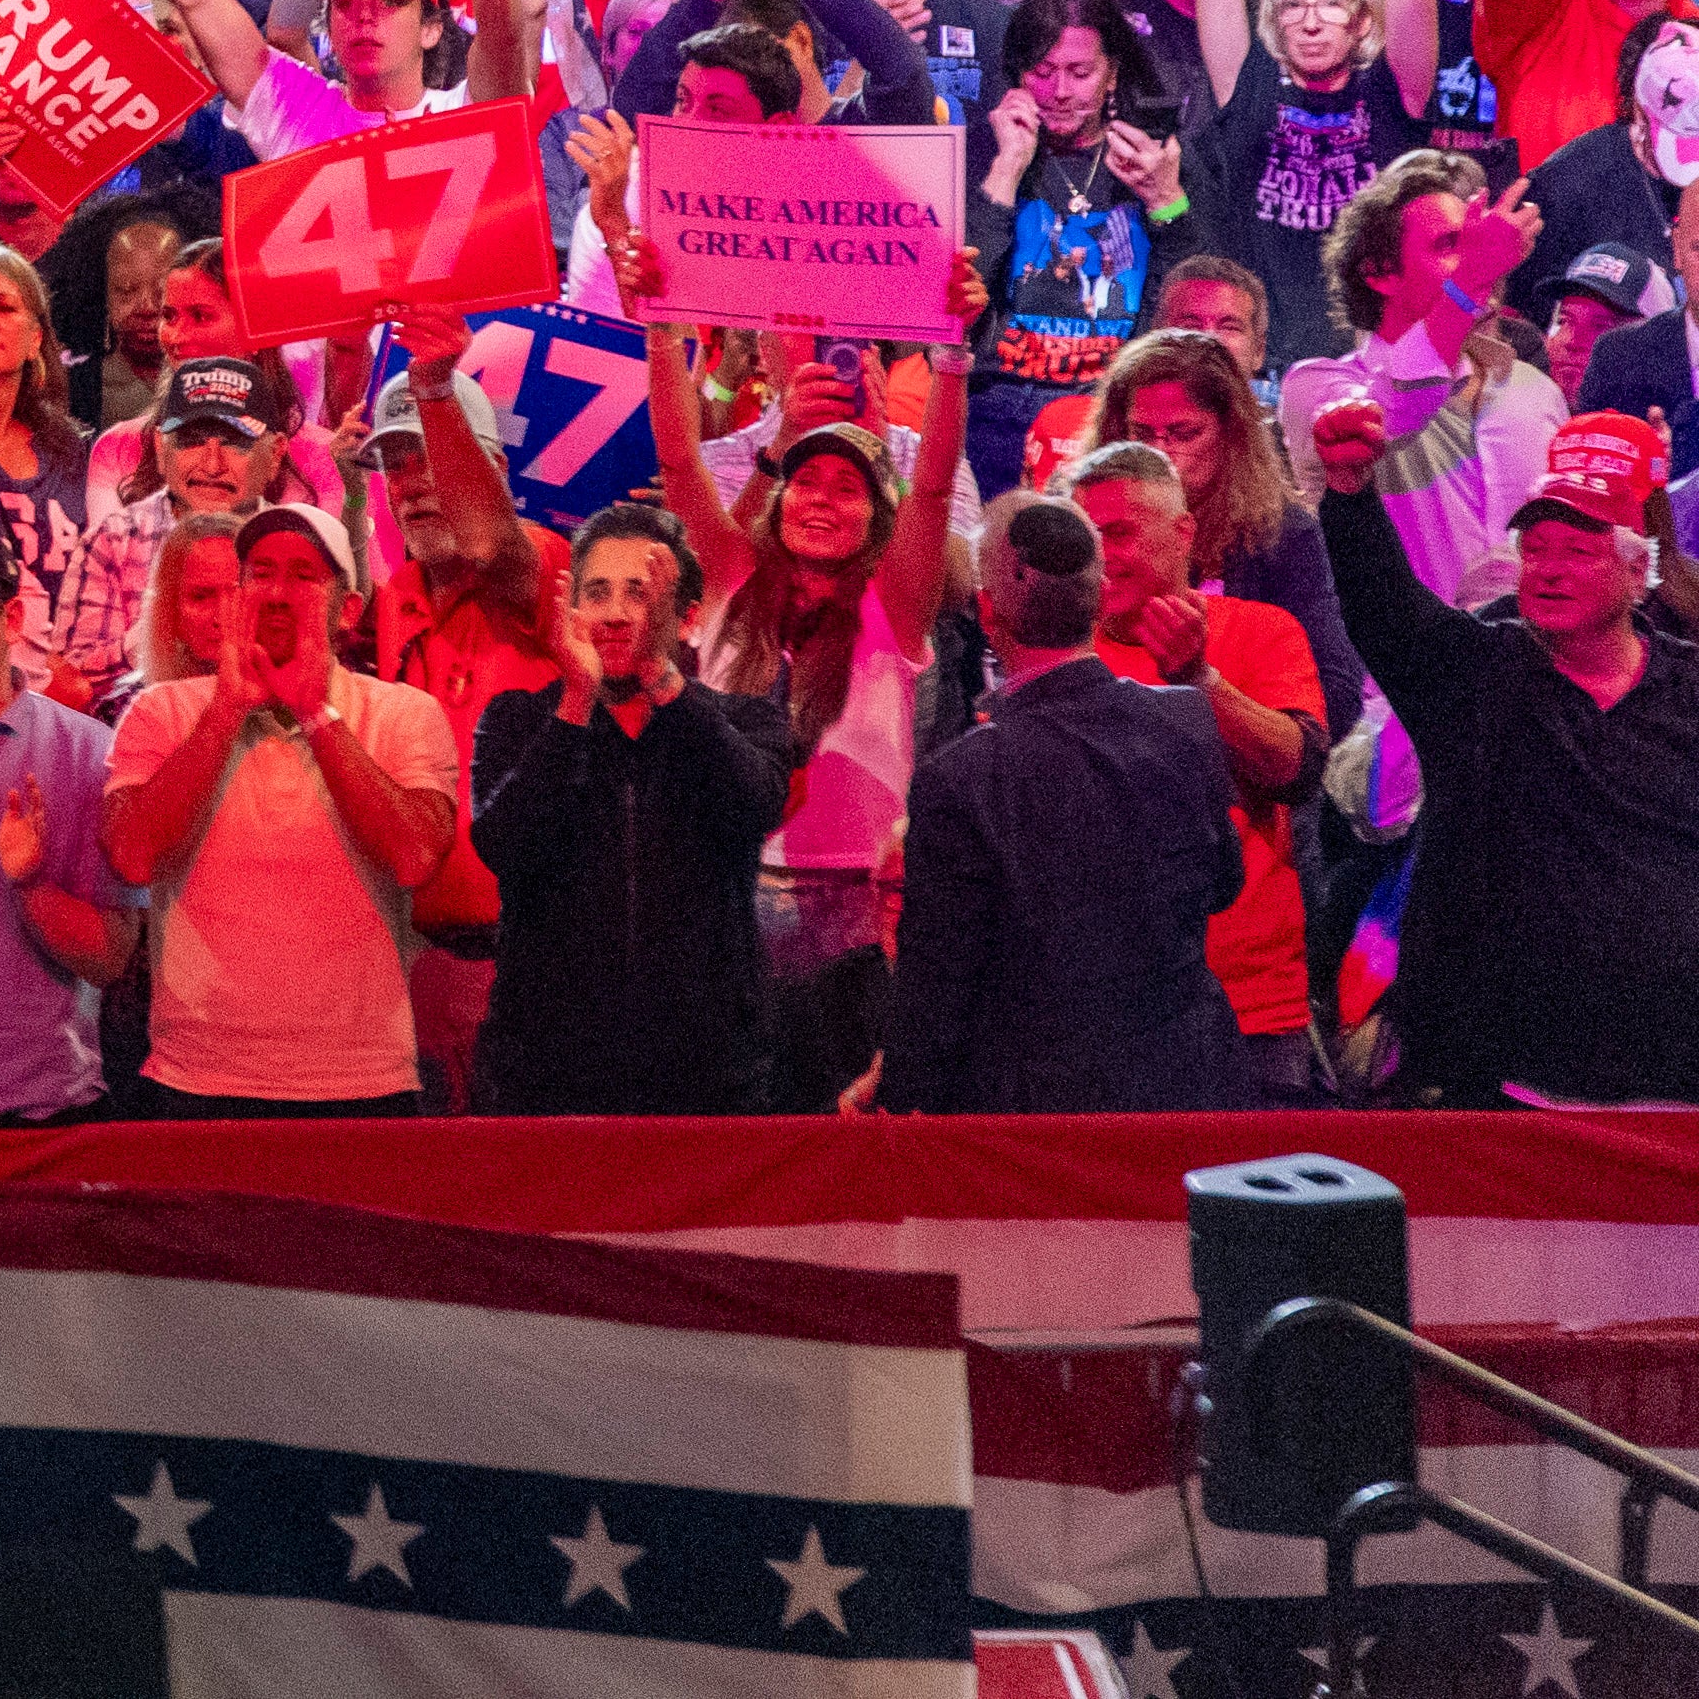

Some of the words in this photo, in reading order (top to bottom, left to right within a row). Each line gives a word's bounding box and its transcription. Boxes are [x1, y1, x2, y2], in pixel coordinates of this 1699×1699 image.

[13, 103, 48, 137] GREAT
[260, 136, 497, 296] 47
[660, 190, 761, 222] MAKE
[769, 198, 943, 229] AMERICA
[1255, 192, 1334, 231] TRU
[677, 229, 798, 260] GREAT
[805, 237, 922, 266] AGAIN
[773, 313, 826, 328] 2024
[180, 368, 253, 394] Trump
[465, 317, 648, 486] 47
